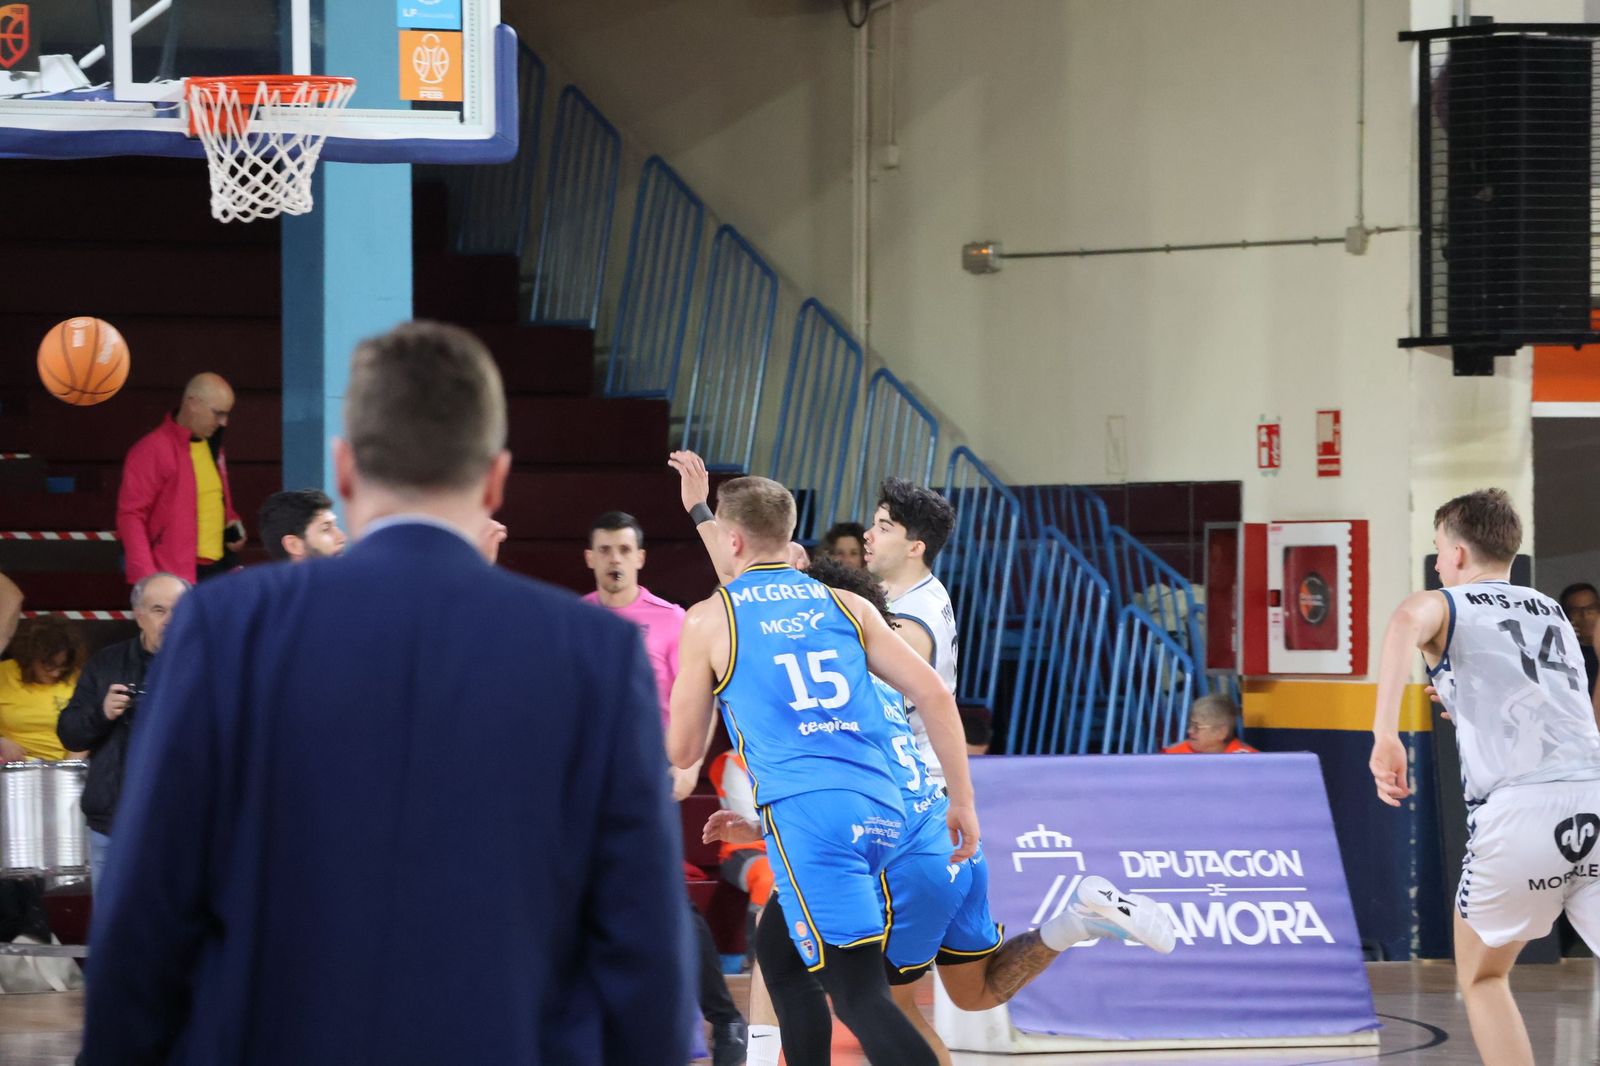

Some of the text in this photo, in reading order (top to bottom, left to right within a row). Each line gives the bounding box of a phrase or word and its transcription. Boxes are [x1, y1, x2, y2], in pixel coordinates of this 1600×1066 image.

[731, 583, 827, 607] MCGREW
[760, 616, 804, 635] MGS
[1497, 619, 1580, 692] 14
[773, 649, 850, 711] 15
[1528, 863, 1600, 891] MORALE
[1124, 901, 1336, 946] AMORA
